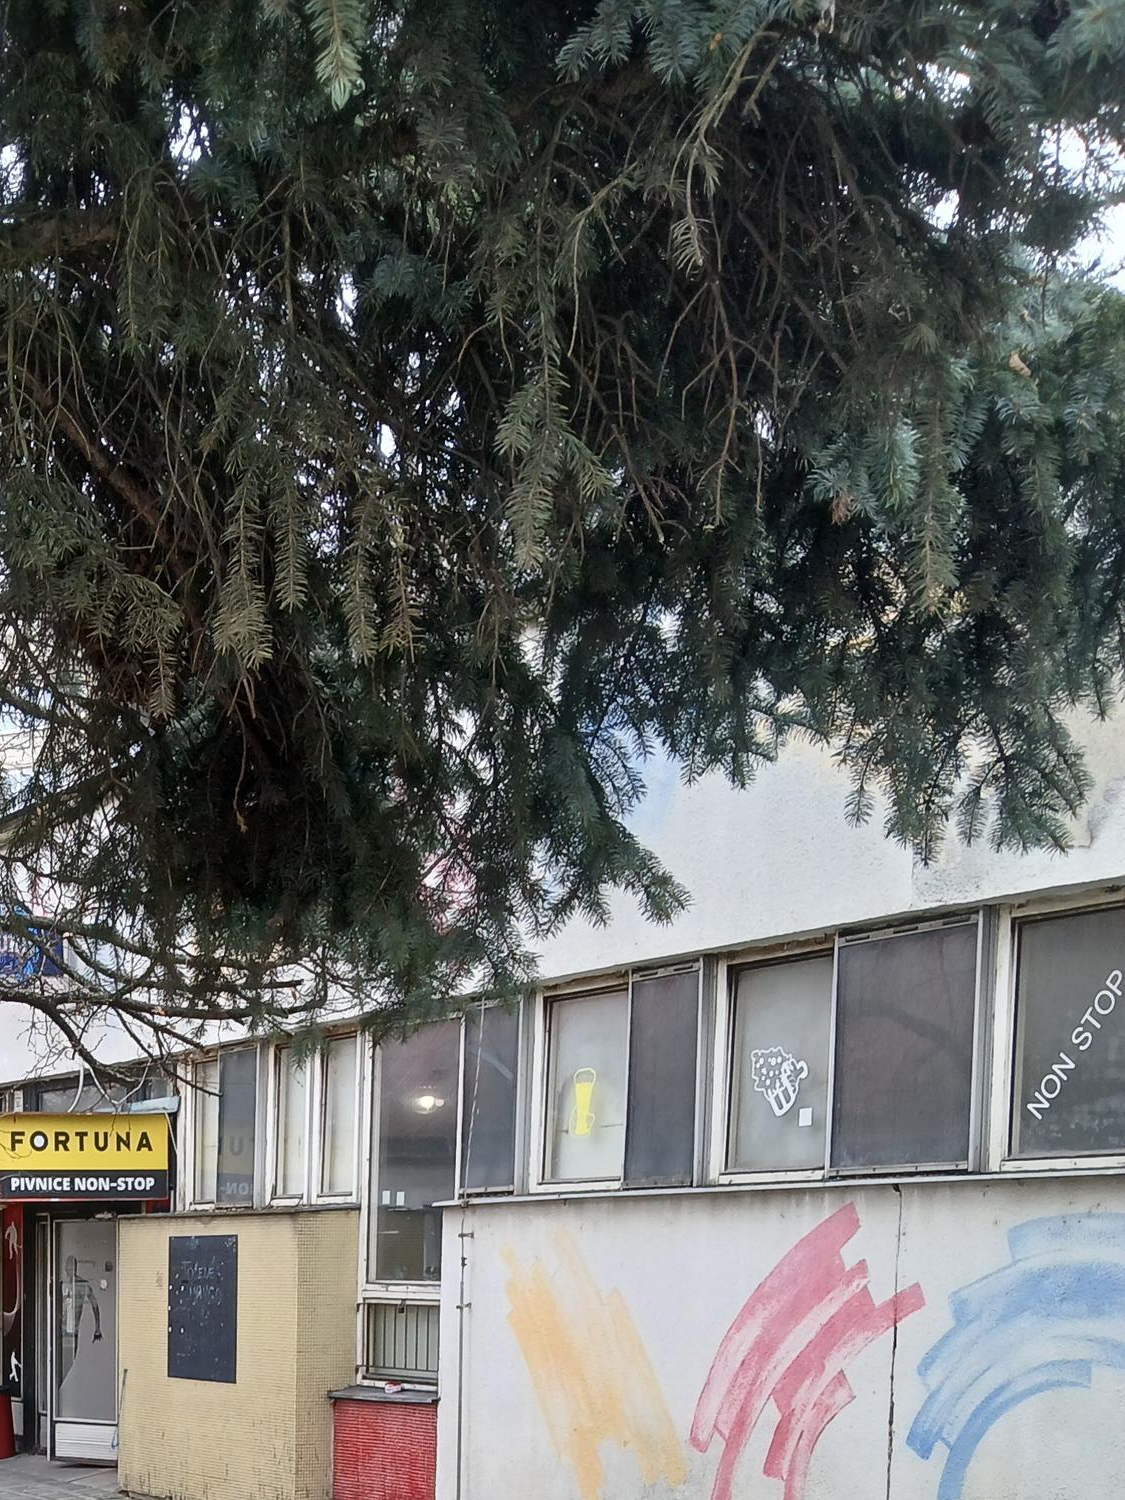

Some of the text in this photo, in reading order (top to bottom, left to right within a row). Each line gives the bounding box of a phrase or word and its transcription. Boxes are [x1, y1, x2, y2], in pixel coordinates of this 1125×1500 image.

[1026, 969, 1123, 1120] NON STOP
[10, 1130, 154, 1153] FORTUNA
[10, 1176, 156, 1192] PIVNICE NON-STOP
